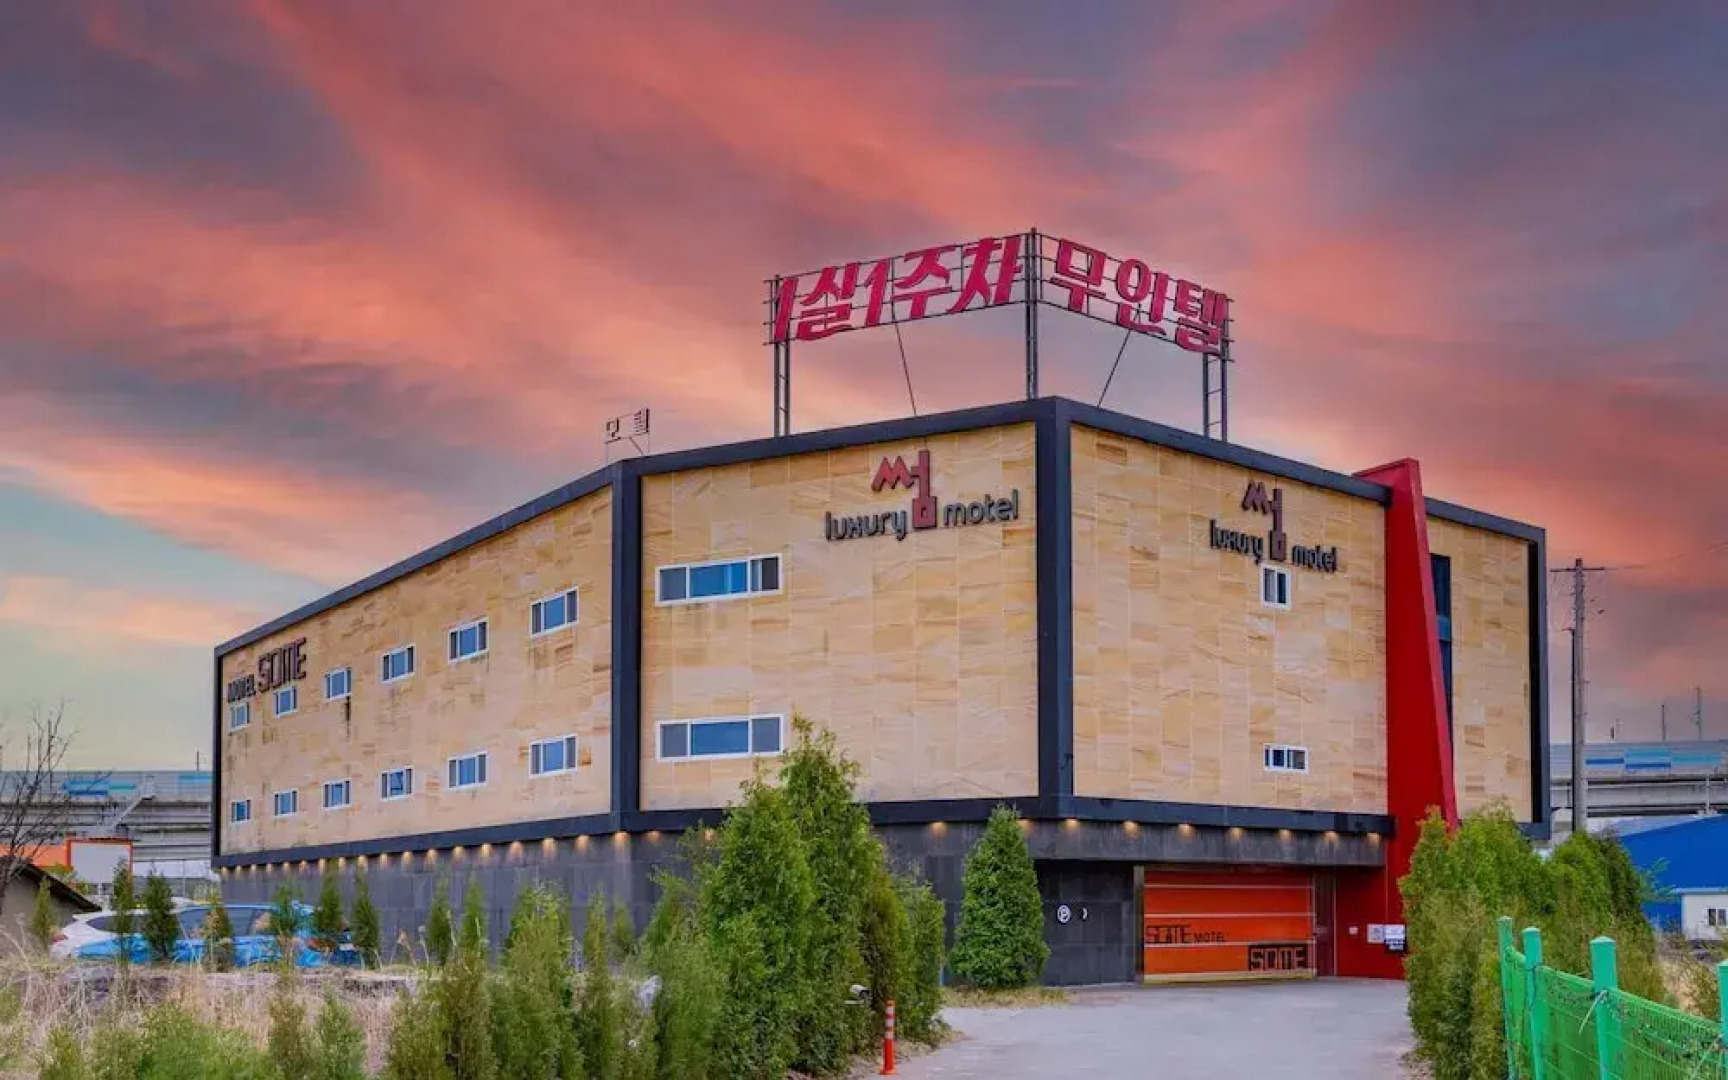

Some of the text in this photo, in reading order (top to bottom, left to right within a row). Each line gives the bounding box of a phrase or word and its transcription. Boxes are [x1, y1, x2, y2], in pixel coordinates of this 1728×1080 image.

[1050, 237, 1228, 357] 무인텔
[825, 488, 1020, 542] luxury motel
[1209, 519, 1338, 574] luxury motel
